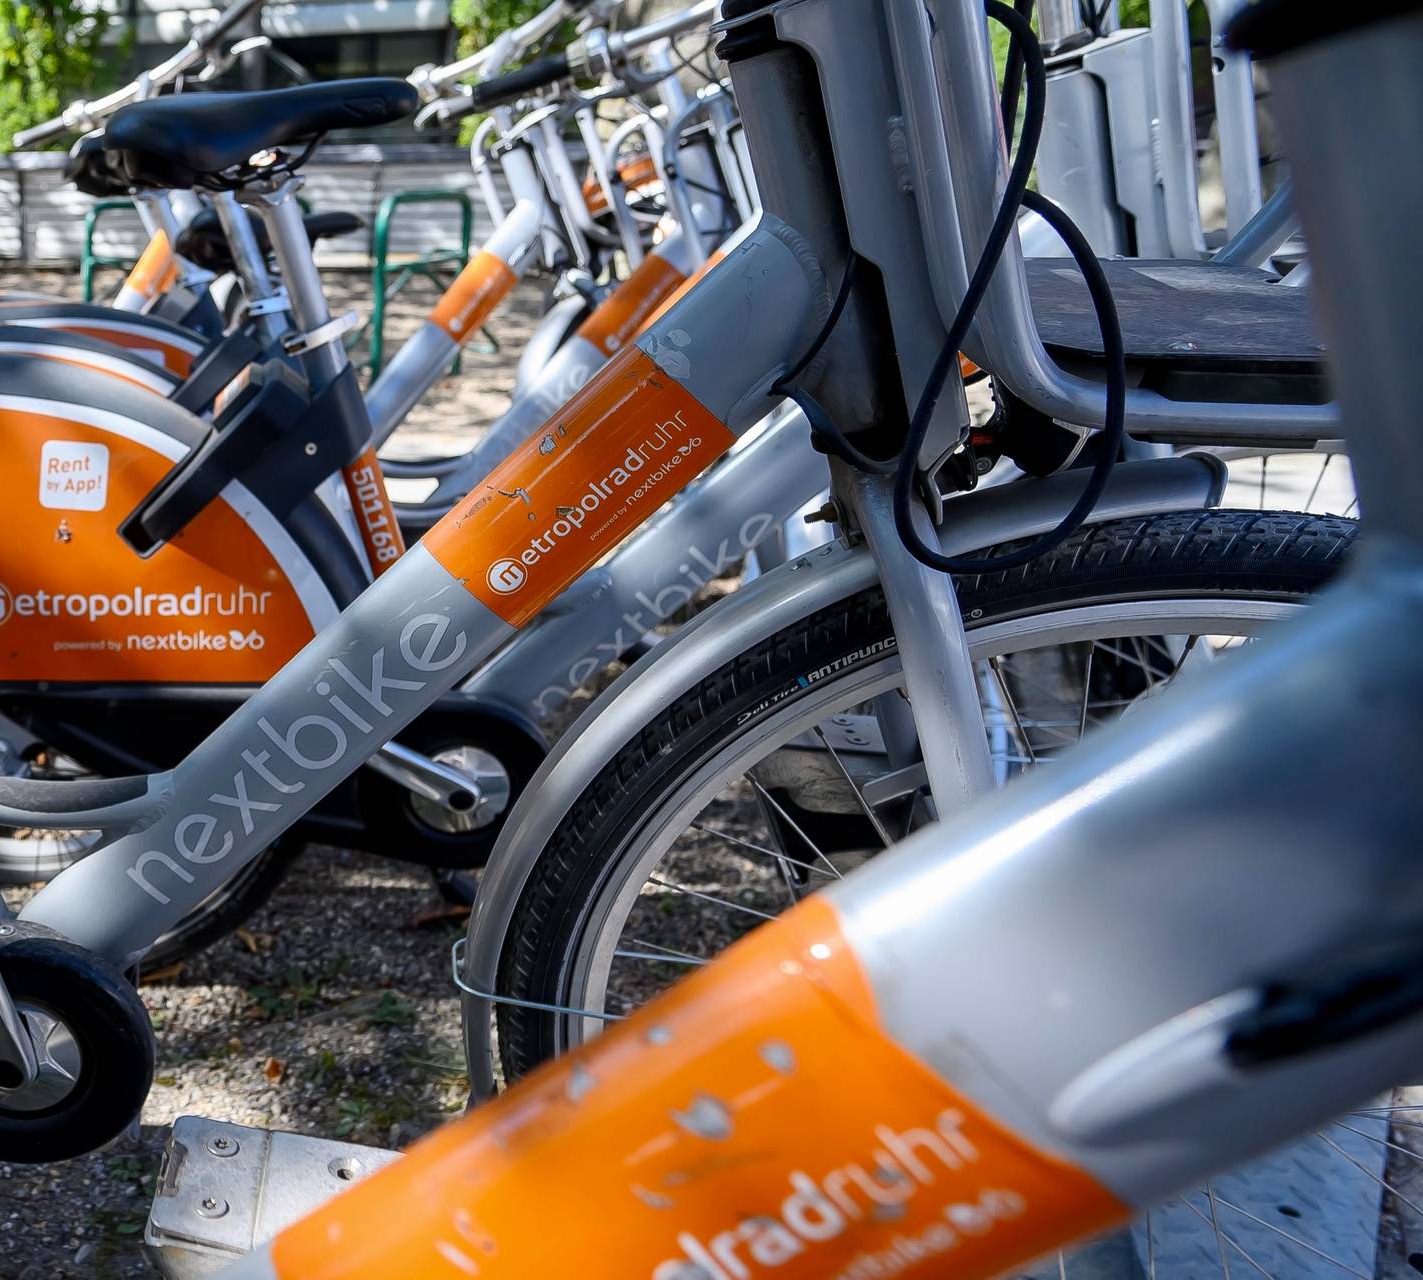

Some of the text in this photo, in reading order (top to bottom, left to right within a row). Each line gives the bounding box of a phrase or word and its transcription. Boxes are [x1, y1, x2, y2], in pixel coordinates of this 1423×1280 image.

[47, 475, 102, 496] by App!
[48, 456, 90, 475] Rent
[486, 409, 688, 596] metropolradruhr
[590, 514, 619, 541] powered
[626, 455, 682, 506] nextbike
[352, 466, 398, 562] 501168
[126, 629, 227, 651] nextbike
[125, 612, 467, 905] nextbike
